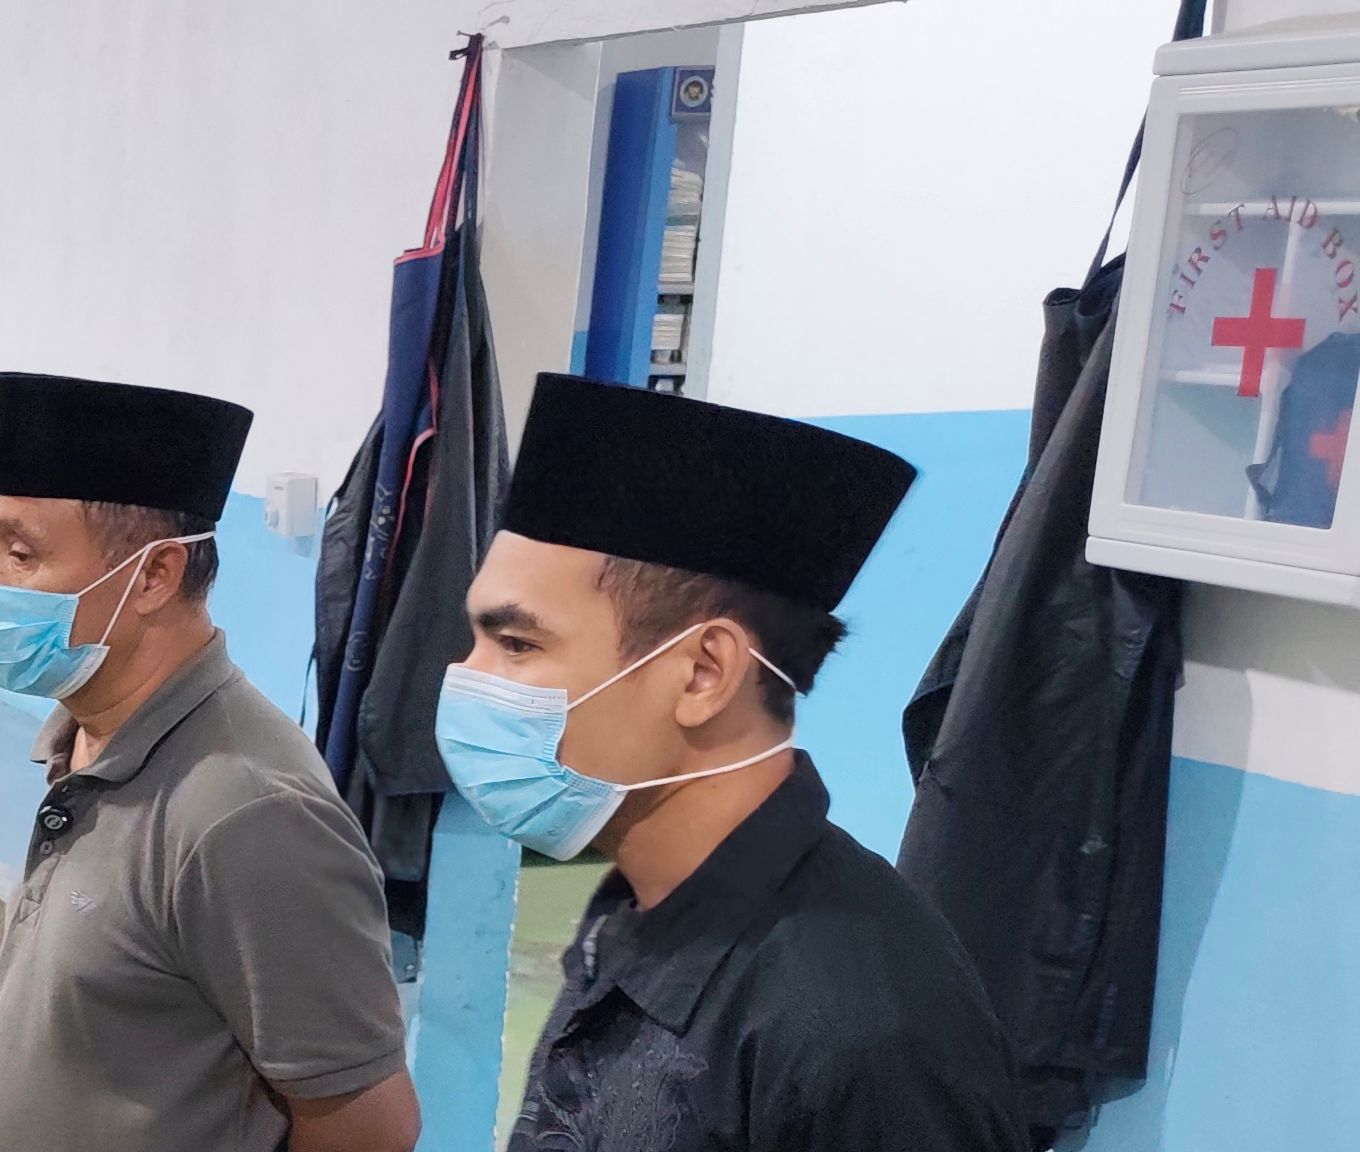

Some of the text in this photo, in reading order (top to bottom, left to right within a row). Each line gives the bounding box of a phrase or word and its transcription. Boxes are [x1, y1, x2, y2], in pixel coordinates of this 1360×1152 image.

[1167, 194, 1359, 322] FIRST AID BOX
